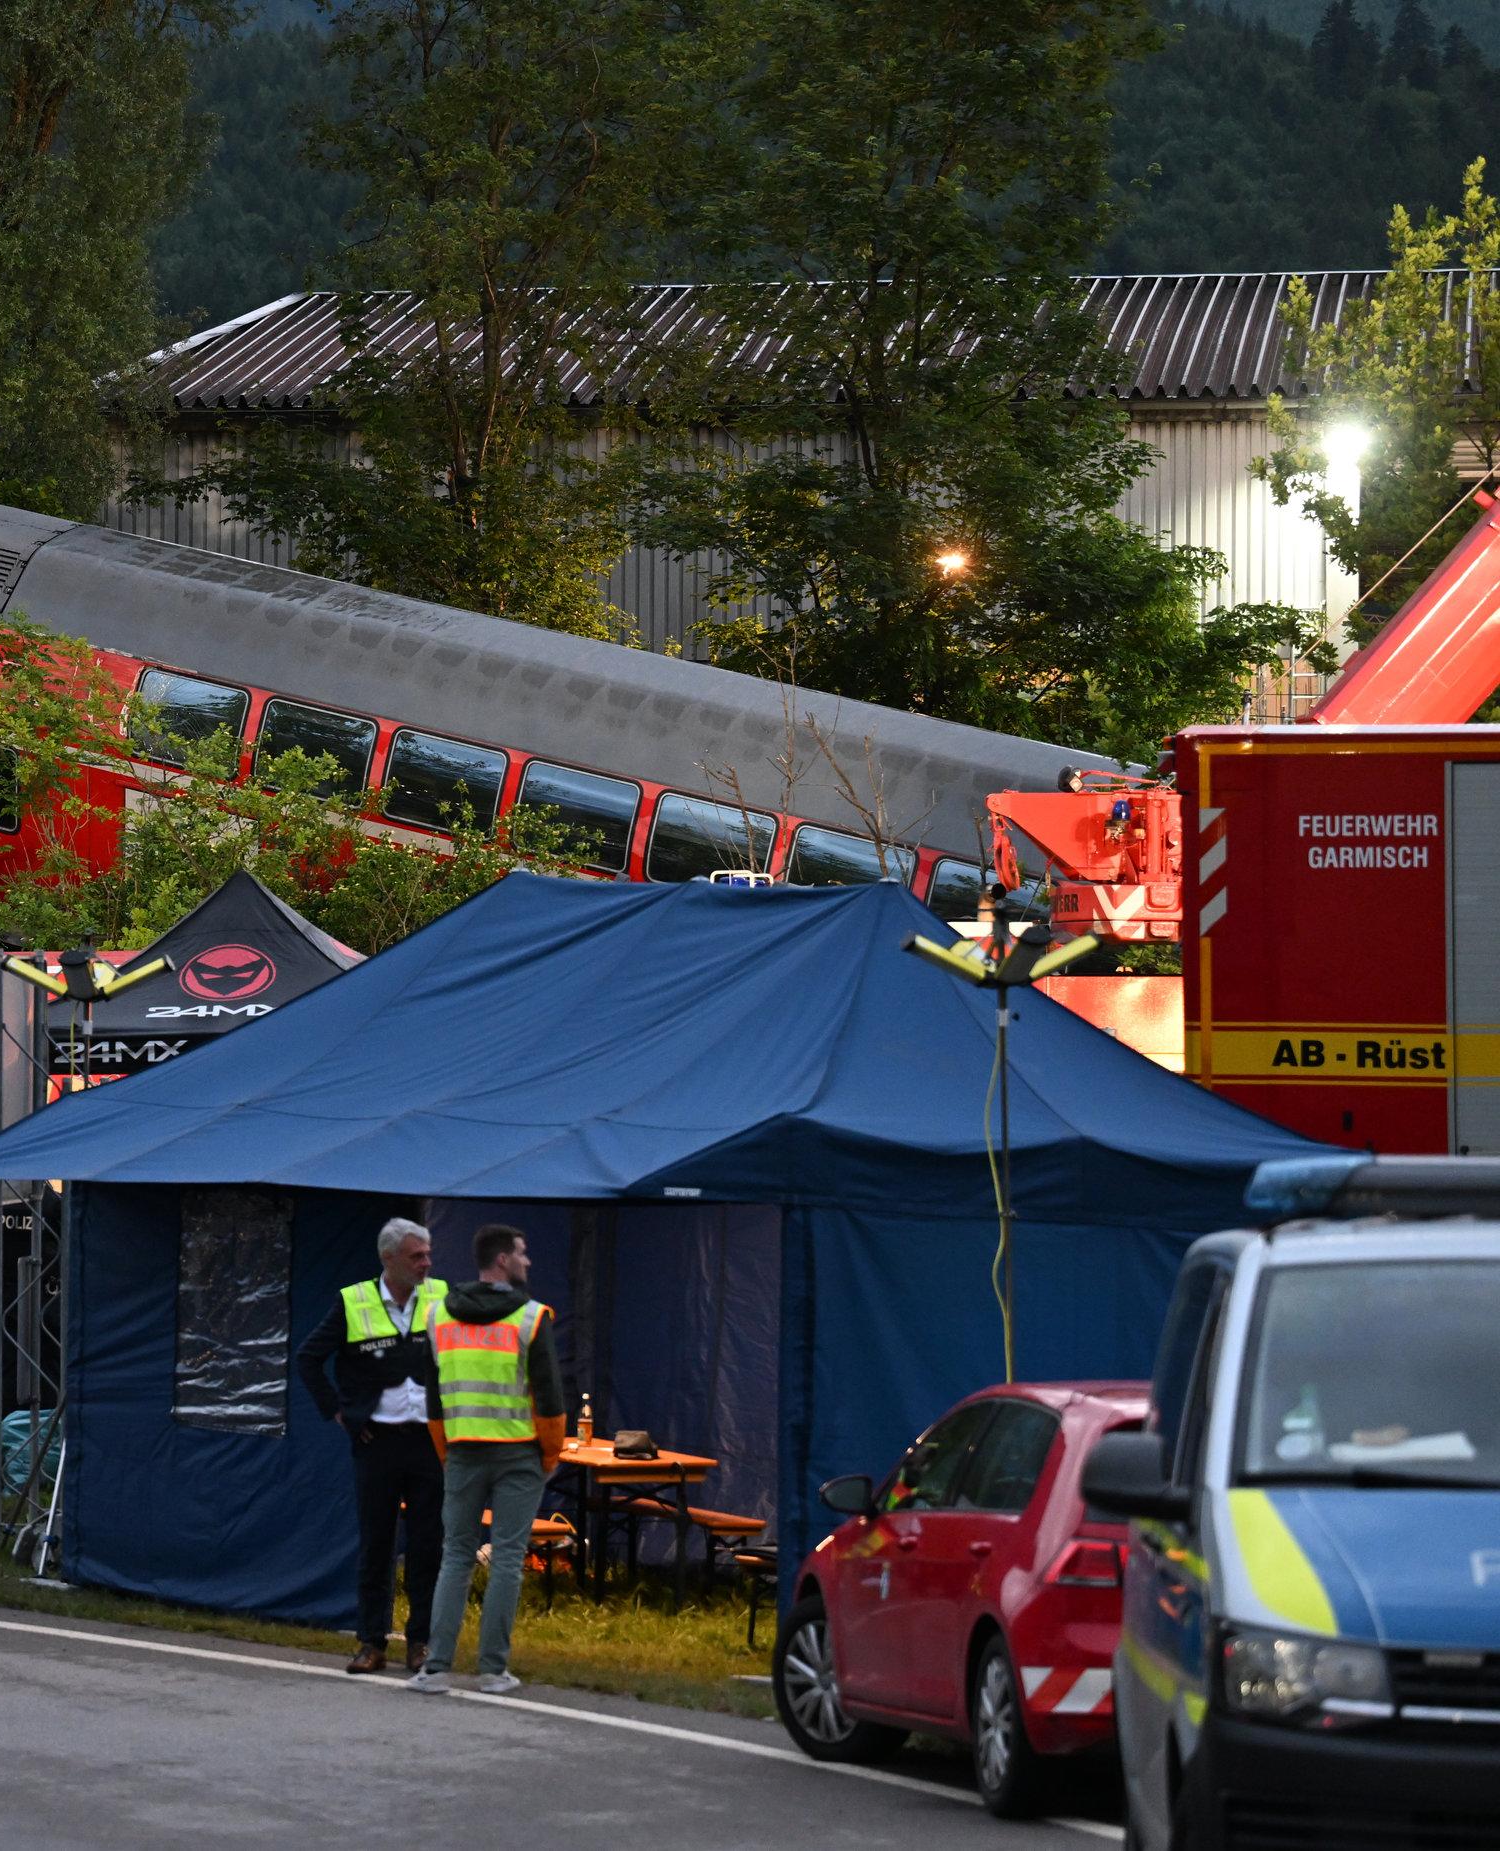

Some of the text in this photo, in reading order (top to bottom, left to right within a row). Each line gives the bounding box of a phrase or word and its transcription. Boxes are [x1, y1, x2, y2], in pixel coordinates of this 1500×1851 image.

[1298, 814, 1439, 837] FEUERWEHR
[1307, 846, 1429, 869] GARMISCH
[1271, 1039, 1326, 1068] AB
[1356, 1040, 1447, 1070] Rüst
